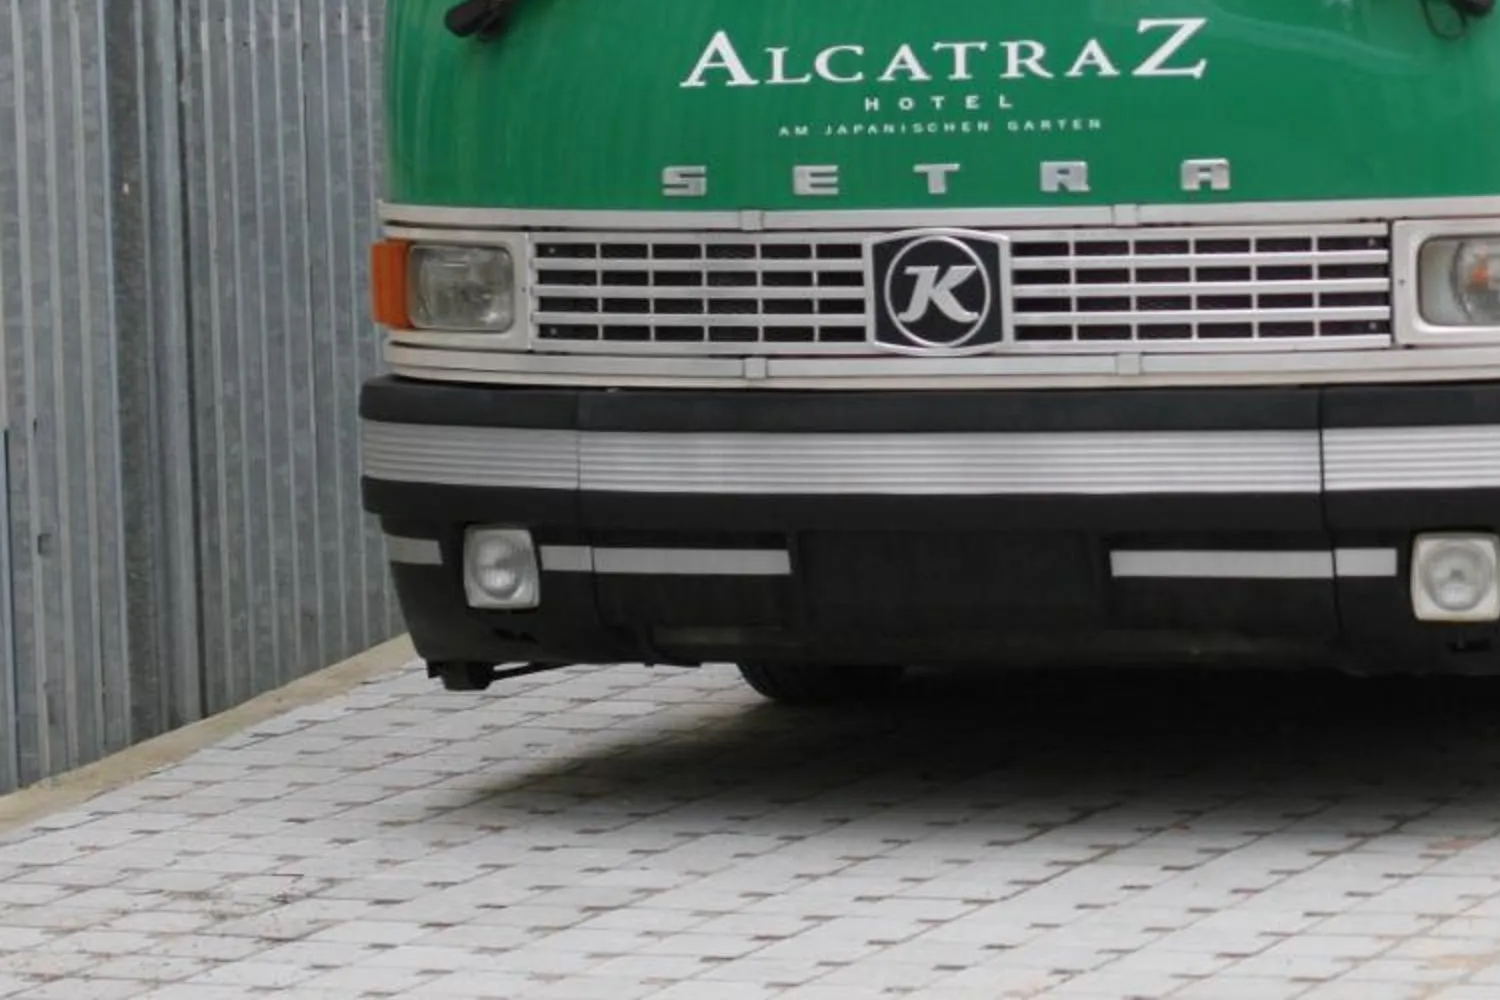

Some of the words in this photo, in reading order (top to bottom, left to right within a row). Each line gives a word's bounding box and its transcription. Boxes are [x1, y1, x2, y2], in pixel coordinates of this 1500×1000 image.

[679, 17, 1208, 88] ALCATRAZ
[865, 93, 1012, 112] HOTEL
[779, 124, 810, 137] AM
[825, 121, 991, 136] JAPANISCHEN
[1007, 117, 1102, 132] GARTEN
[661, 158, 1231, 196] SETRA
